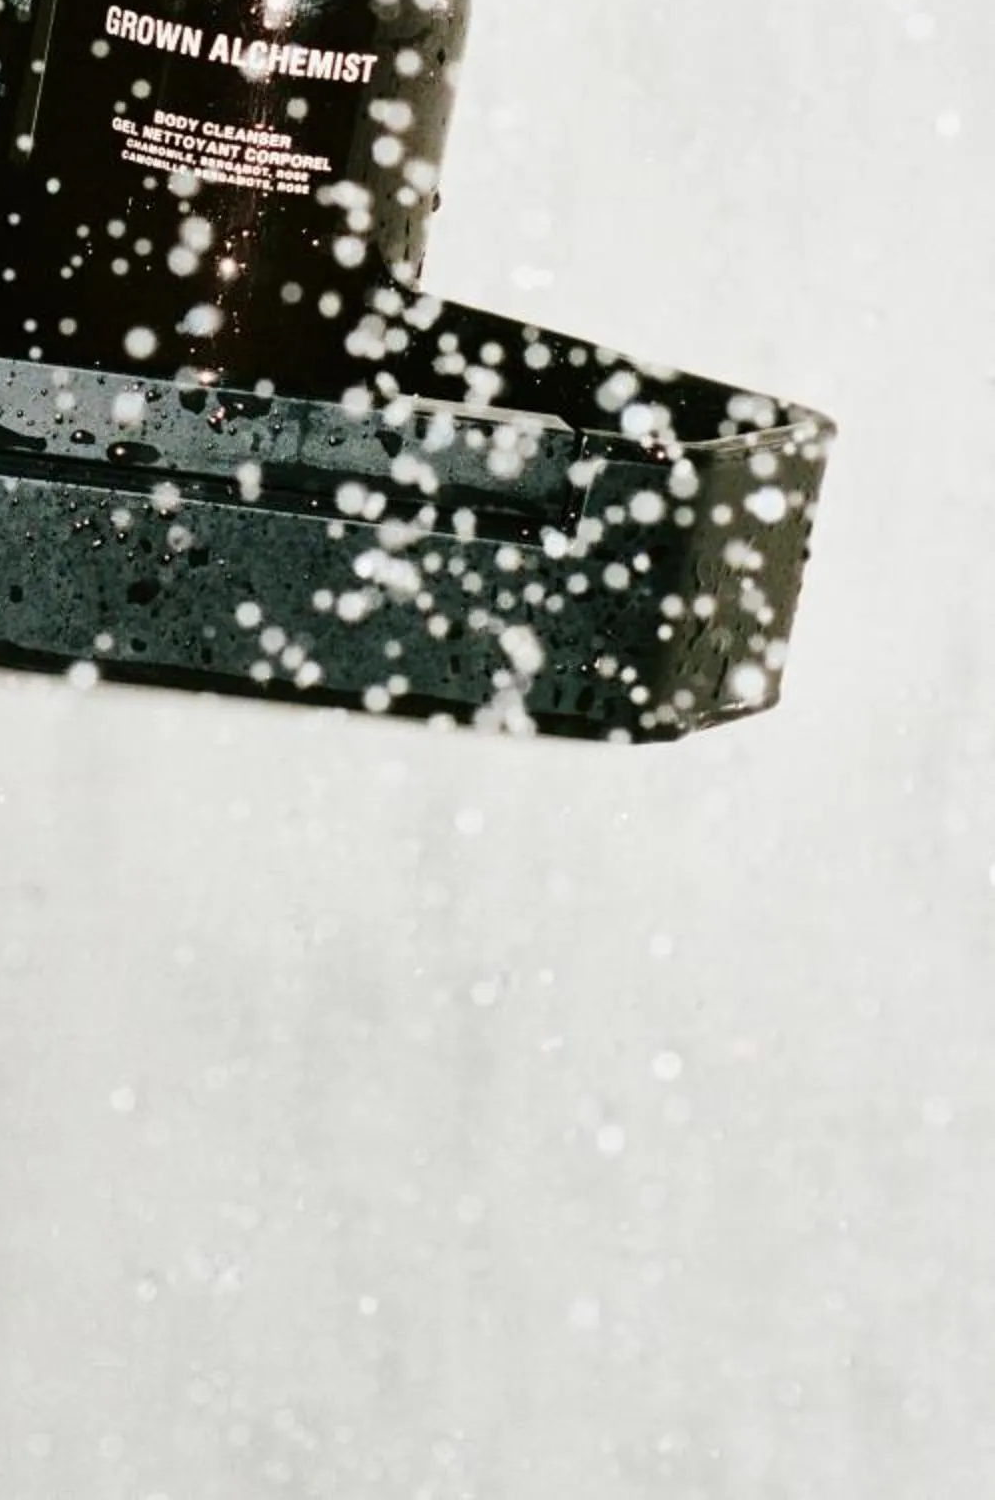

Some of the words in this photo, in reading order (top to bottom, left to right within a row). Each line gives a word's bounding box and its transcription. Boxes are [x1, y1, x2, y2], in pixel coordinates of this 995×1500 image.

[106, 5, 203, 58] GROWN
[209, 33, 378, 83] ALCHEMIST
[112, 116, 139, 136] GEL
[141, 125, 241, 159] NETTOYANT
[244, 146, 332, 172] CORPOREL
[153, 109, 200, 132] BODY
[202, 121, 292, 149] CLEANSER
[276, 181, 310, 195] ROSE
